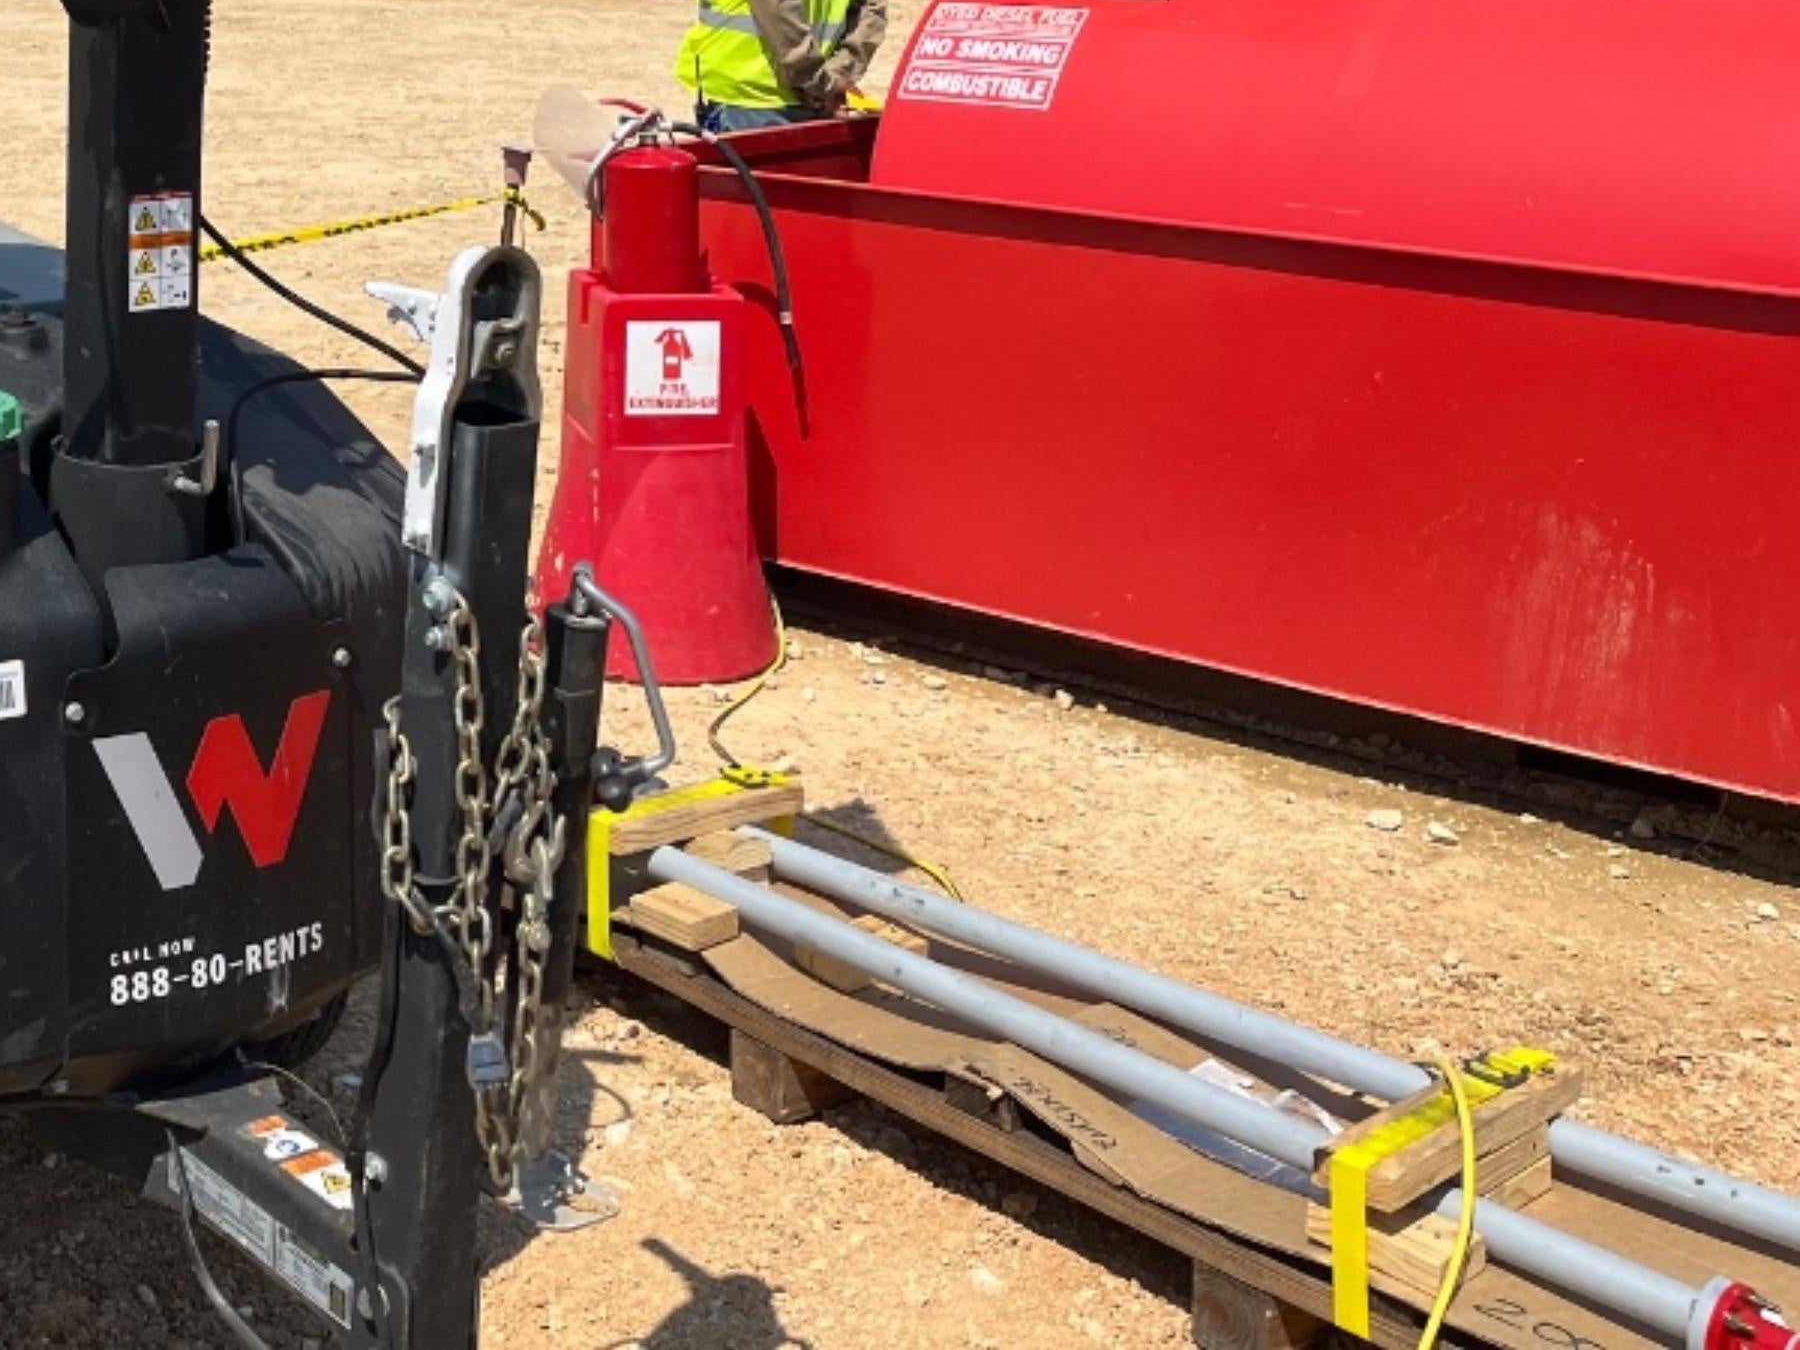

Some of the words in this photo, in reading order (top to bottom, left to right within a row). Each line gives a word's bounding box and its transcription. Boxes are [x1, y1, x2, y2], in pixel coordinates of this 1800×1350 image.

[920, 37, 953, 57] NO
[956, 39, 1062, 64] SMOKING
[907, 70, 1049, 101] COMBUSTIBLE
[109, 921, 323, 1006] 888-80-RENTS
[110, 947, 151, 968] CALL
[158, 936, 196, 958] NOW
